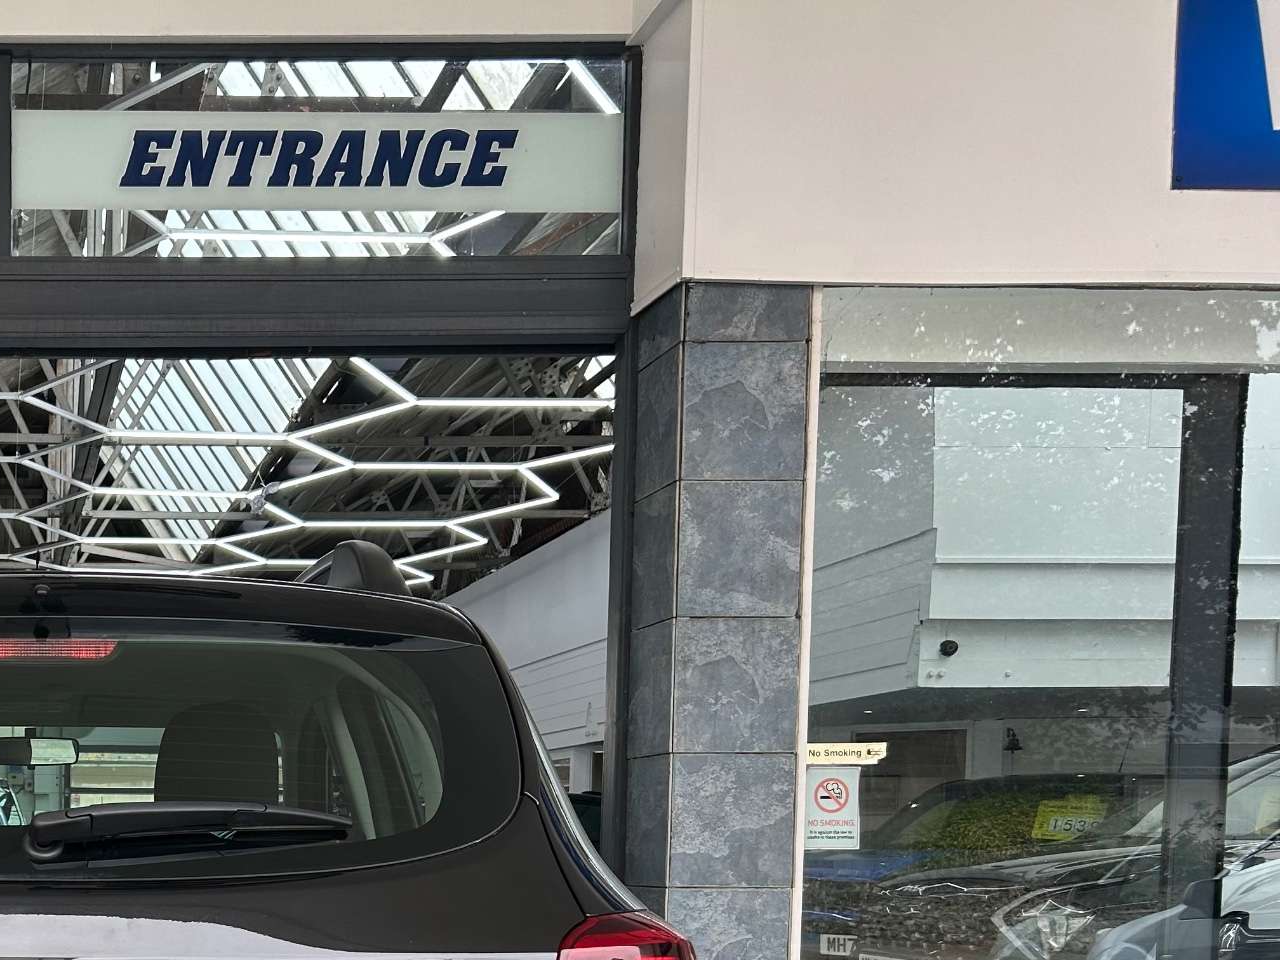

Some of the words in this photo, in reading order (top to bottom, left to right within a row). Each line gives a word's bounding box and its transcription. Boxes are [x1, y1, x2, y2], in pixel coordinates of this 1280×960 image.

[120, 128, 519, 189] ENTRANCE
[808, 749, 821, 757] No
[823, 749, 862, 758] Smoking
[807, 819, 819, 827] NO
